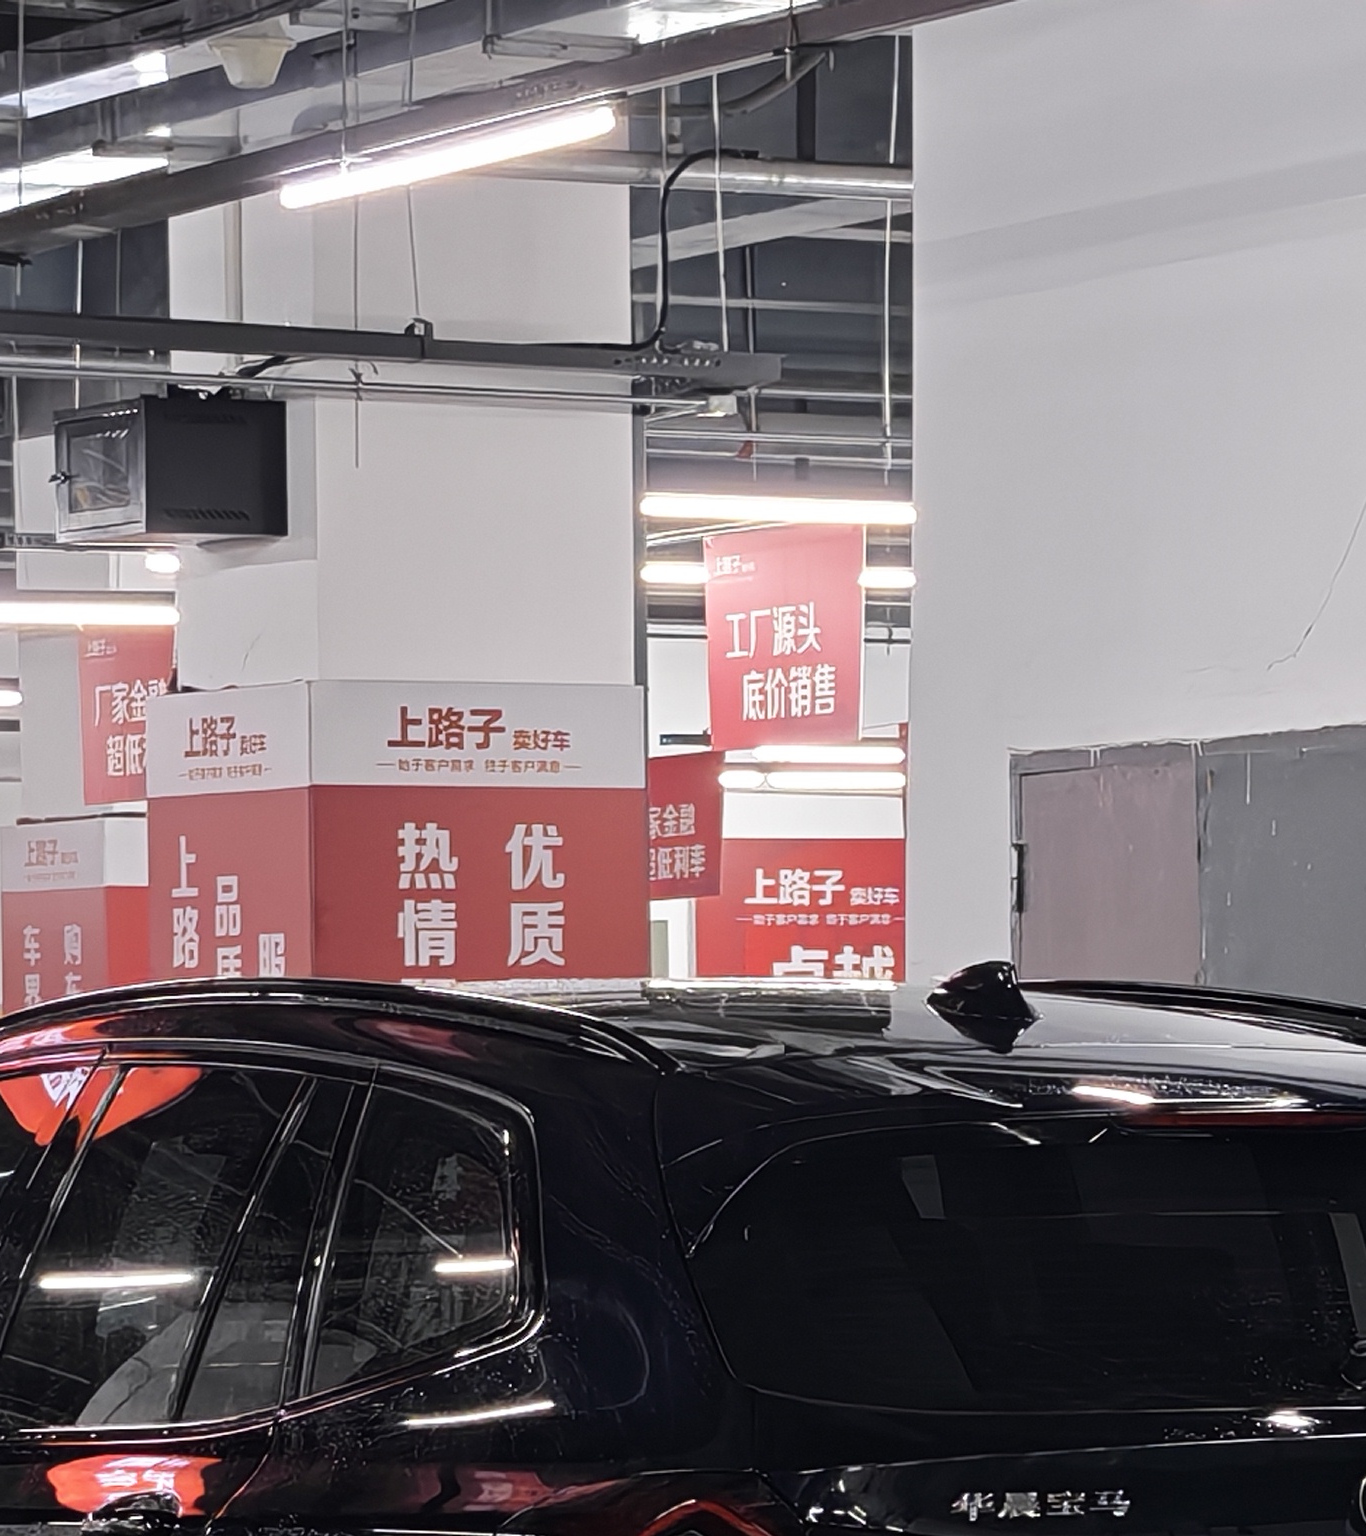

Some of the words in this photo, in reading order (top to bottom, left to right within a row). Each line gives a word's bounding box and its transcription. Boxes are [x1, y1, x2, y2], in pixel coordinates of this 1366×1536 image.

[724, 601, 823, 660] 工厂源头
[742, 663, 837, 722] 底价销售
[184, 715, 237, 758] 上路子
[387, 706, 506, 750] 上路子
[512, 729, 571, 751] 卖好车
[107, 734, 147, 778] 超低
[398, 821, 459, 986] 热情
[505, 822, 565, 968] 优质
[743, 868, 846, 906] 上路子
[950, 1489, 1131, 1521] 华晨宝马
